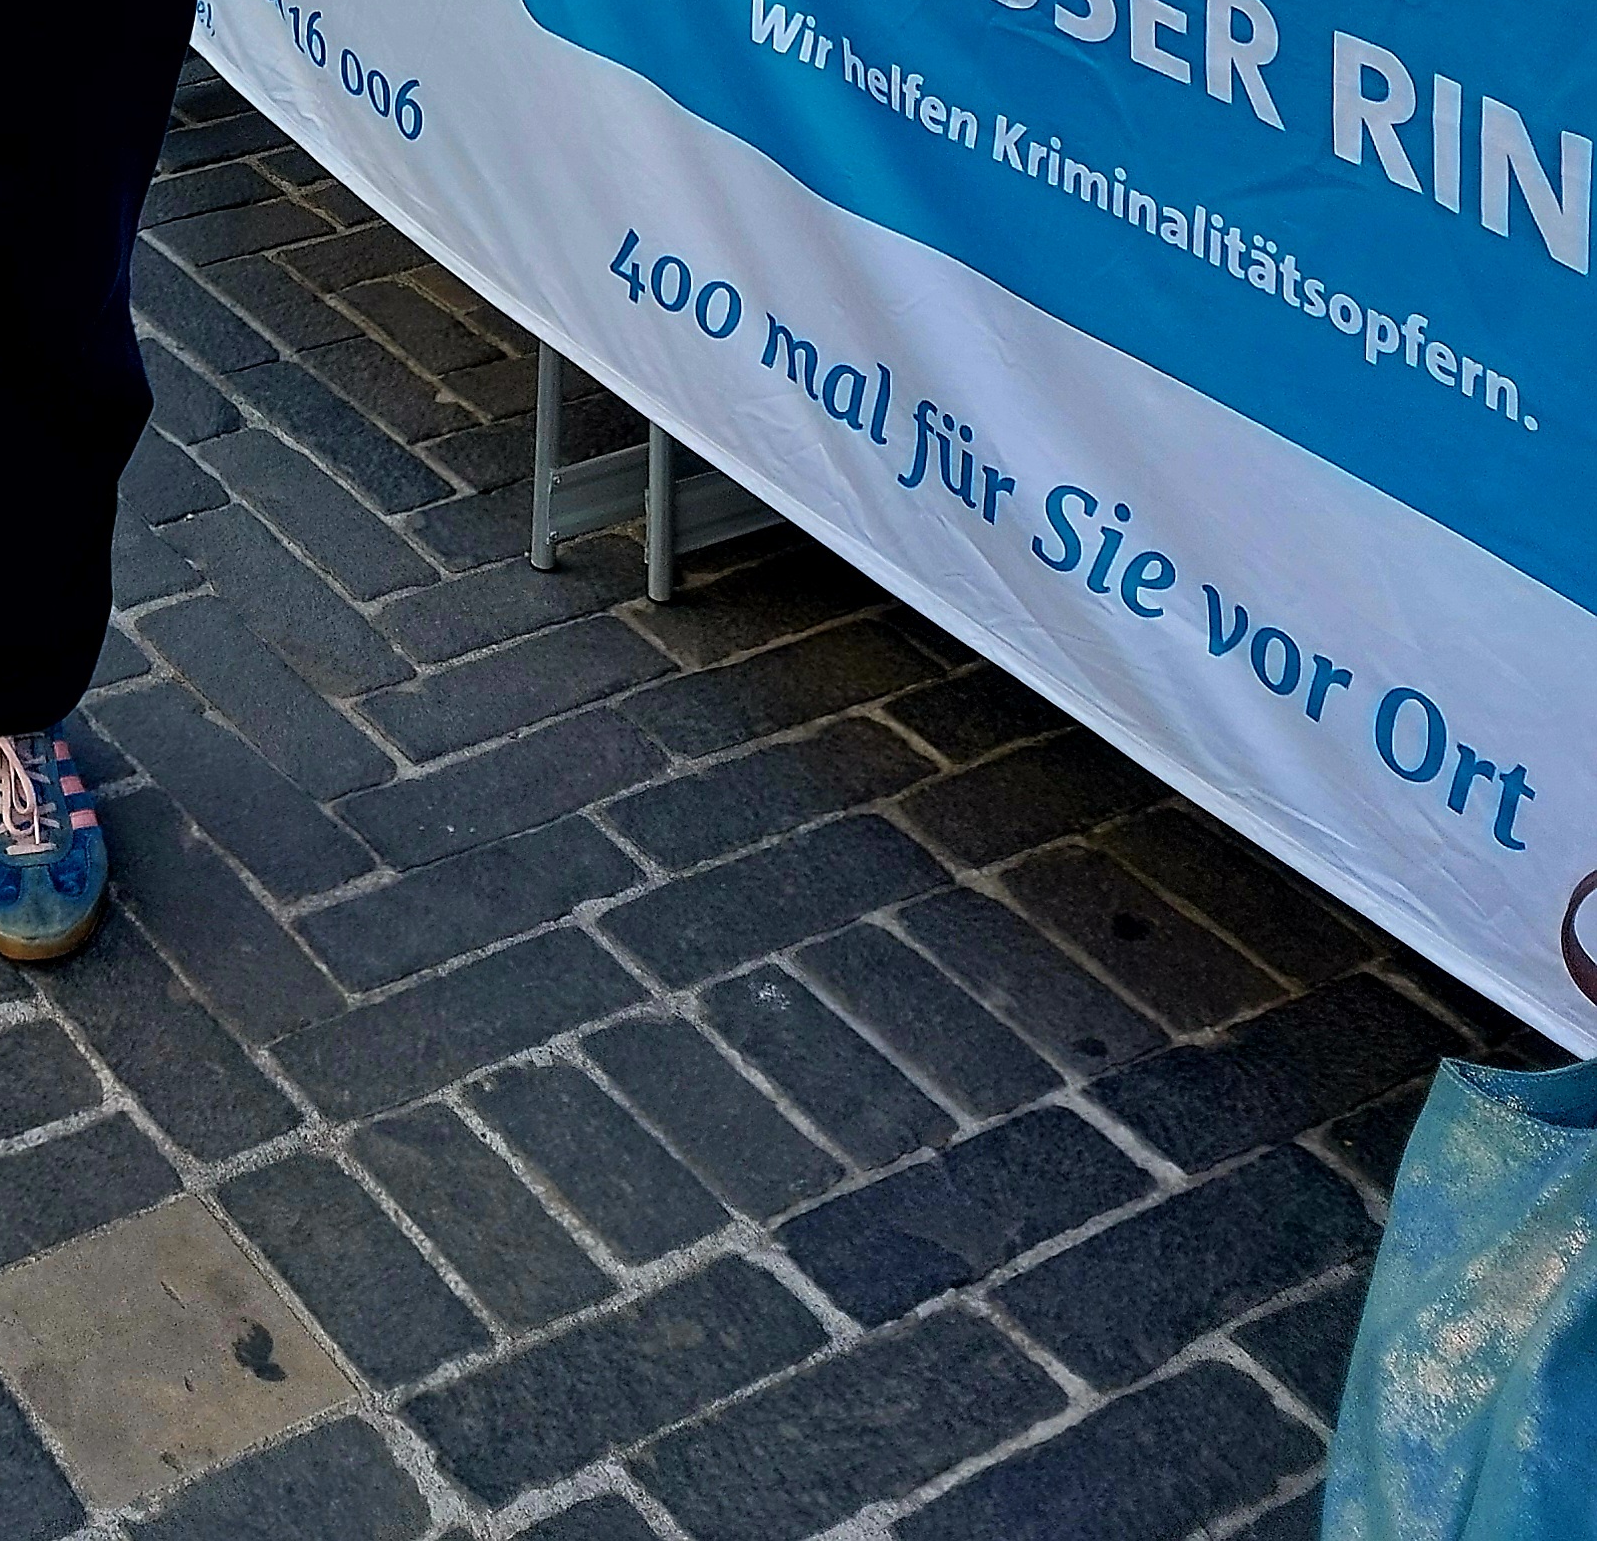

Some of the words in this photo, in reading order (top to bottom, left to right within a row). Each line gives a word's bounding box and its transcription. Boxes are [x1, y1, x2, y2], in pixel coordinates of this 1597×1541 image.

[340, 48, 423, 140] 006
[842, 39, 978, 150] helfen
[992, 113, 1541, 432] Kriminalitätsopfern.
[1333, 30, 1594, 275] RIN
[608, 228, 743, 340] 400
[760, 311, 894, 446] mal
[897, 398, 1016, 524] für
[1030, 481, 1178, 619] Sie
[1200, 583, 1354, 722] vor
[1373, 687, 1537, 852] Ort
